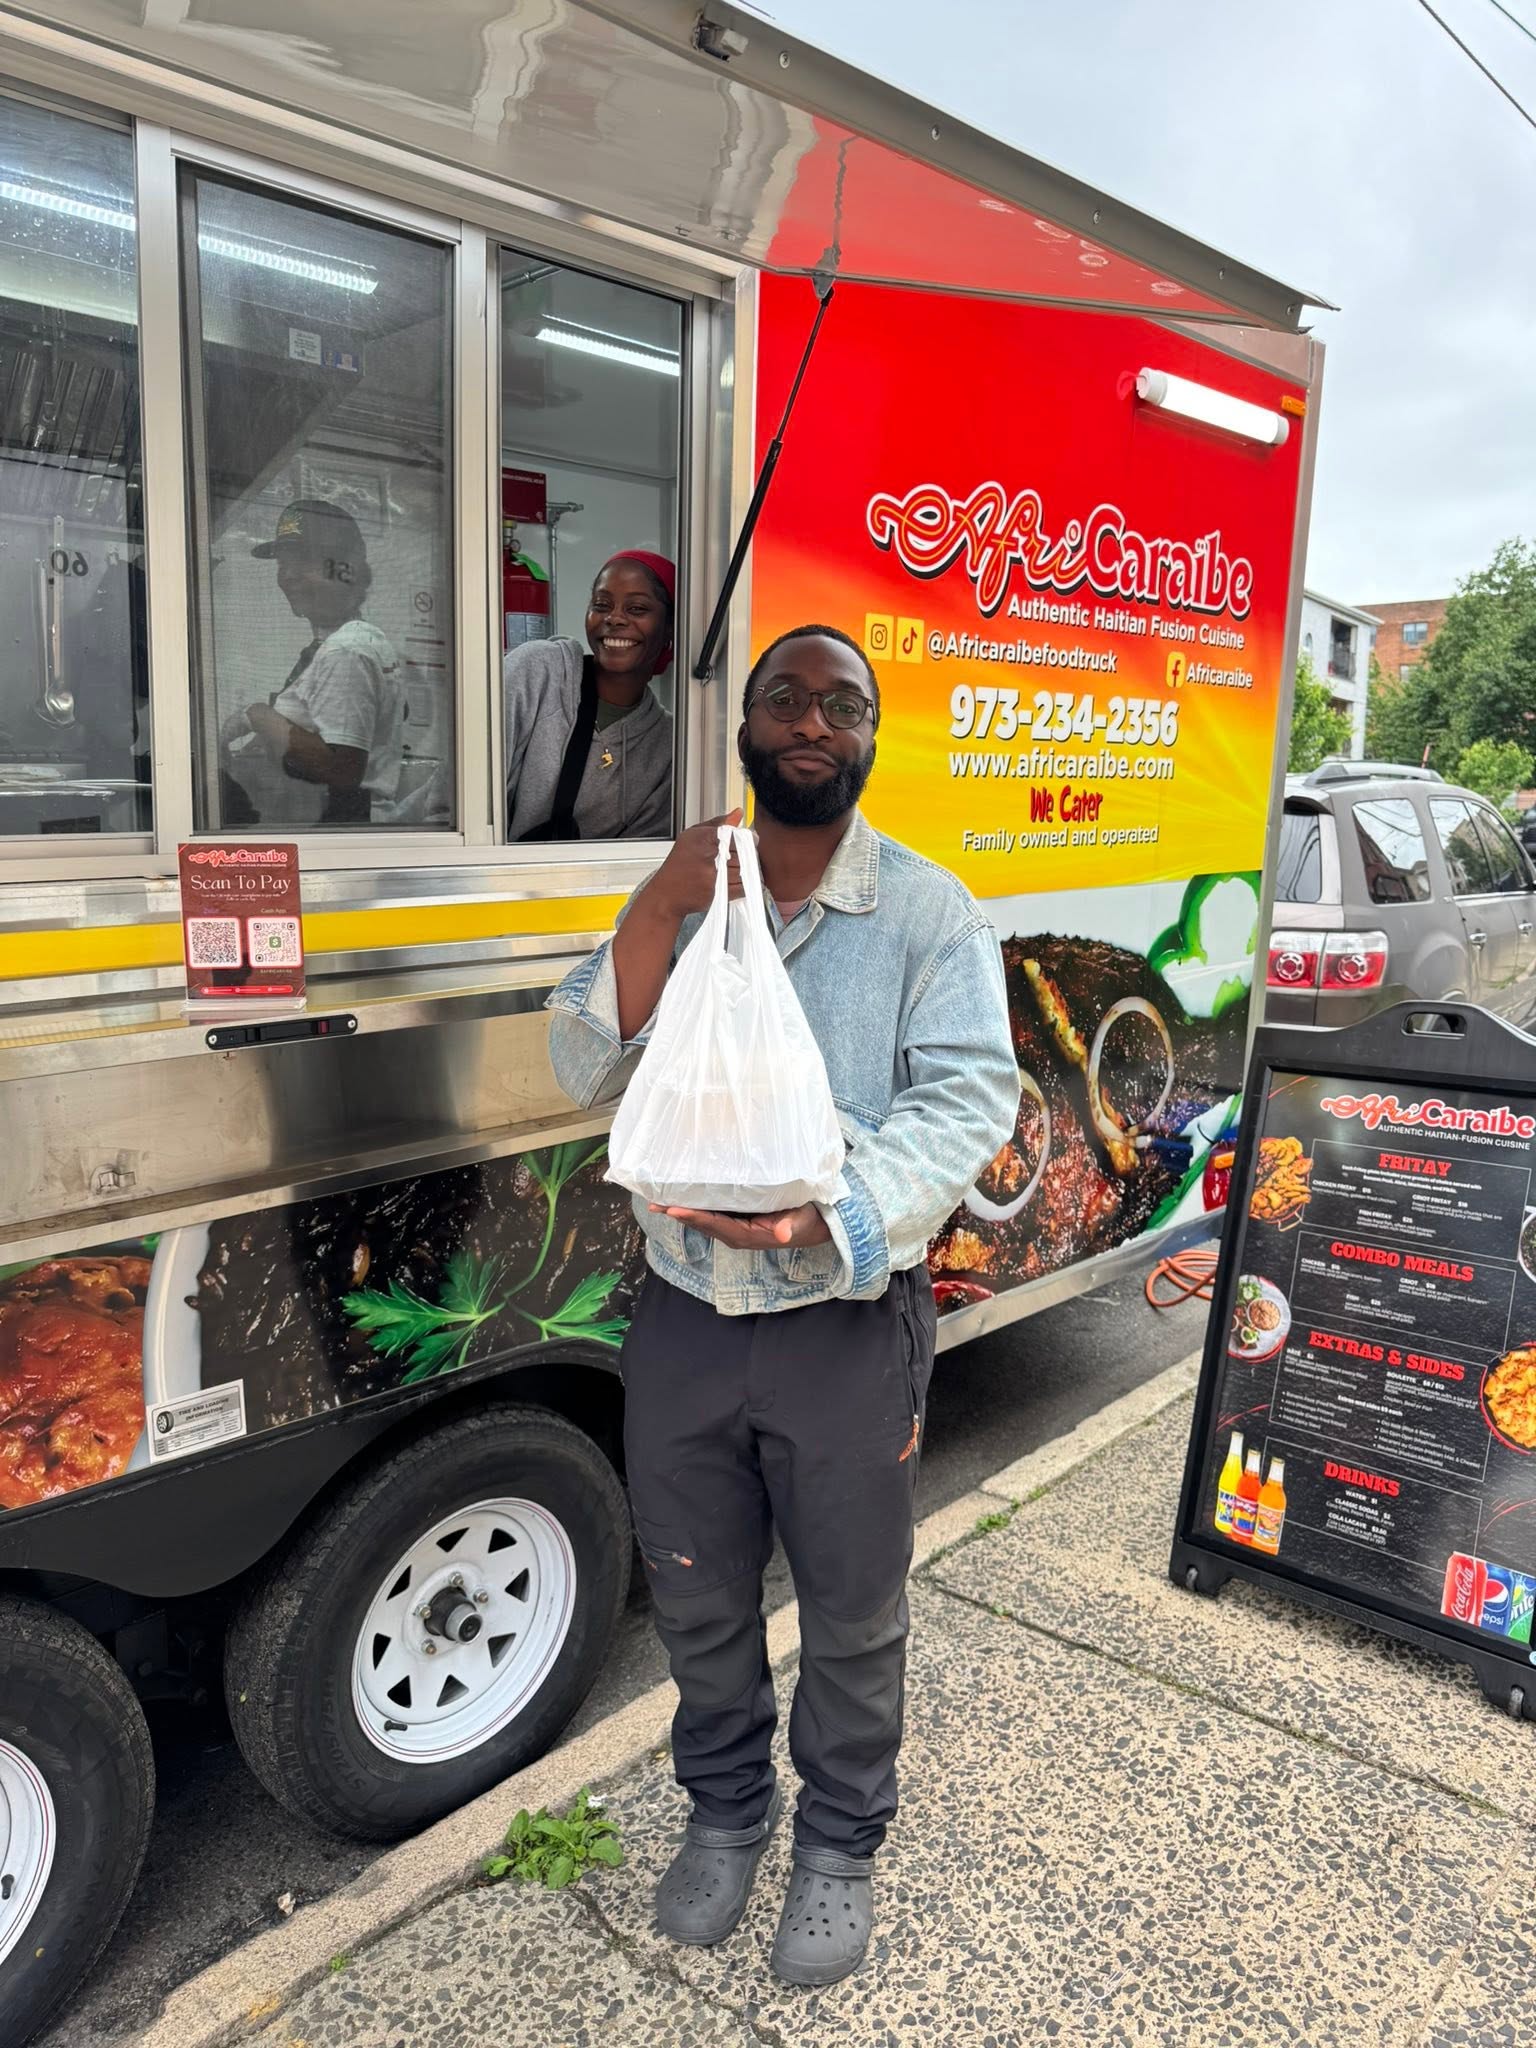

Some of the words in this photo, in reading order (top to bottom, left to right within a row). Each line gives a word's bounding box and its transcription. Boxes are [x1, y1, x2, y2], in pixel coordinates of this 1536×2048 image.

[1007, 594, 1089, 628] Authentic
[1094, 610, 1146, 634] Haitian
[1151, 620, 1196, 643] Fusion
[1200, 625, 1245, 650] Cuisine
[928, 630, 1117, 673] @Africaraibefoodtruck
[1186, 663, 1253, 688] Africaraibe
[950, 685, 1180, 746] 973-234-2356
[949, 748, 1174, 779] www.africaraibe.com
[1030, 787, 1054, 823] We
[1059, 785, 1103, 823] Cater
[963, 829, 1016, 853] Family
[1020, 828, 1068, 848] owned
[1072, 827, 1096, 846] and
[1101, 825, 1159, 846] operated
[191, 875, 231, 890] Scan
[235, 875, 256, 889] To
[261, 875, 291, 894] Pay
[1378, 1124, 1423, 1137] AUTHENTIC
[1424, 1129, 1493, 1147] HAITIAN-FUSION
[1494, 1138, 1531, 1151] CUISINE
[1379, 1154, 1451, 1177] FRITAY
[1330, 1241, 1401, 1267] COMBO
[1404, 1255, 1475, 1282] MEALS
[1310, 1332, 1384, 1362] EXTRAS
[1387, 1349, 1403, 1366] &
[1406, 1354, 1465, 1381] SIDES
[1325, 1462, 1401, 1497] DRINKS
[1335, 1498, 1358, 1510] CLASSIC
[1359, 1505, 1379, 1516] SODAS
[1345, 1490, 1367, 1501] WATER
[1328, 1512, 1344, 1522] COLA
[1483, 1613, 1504, 1626] epsi
